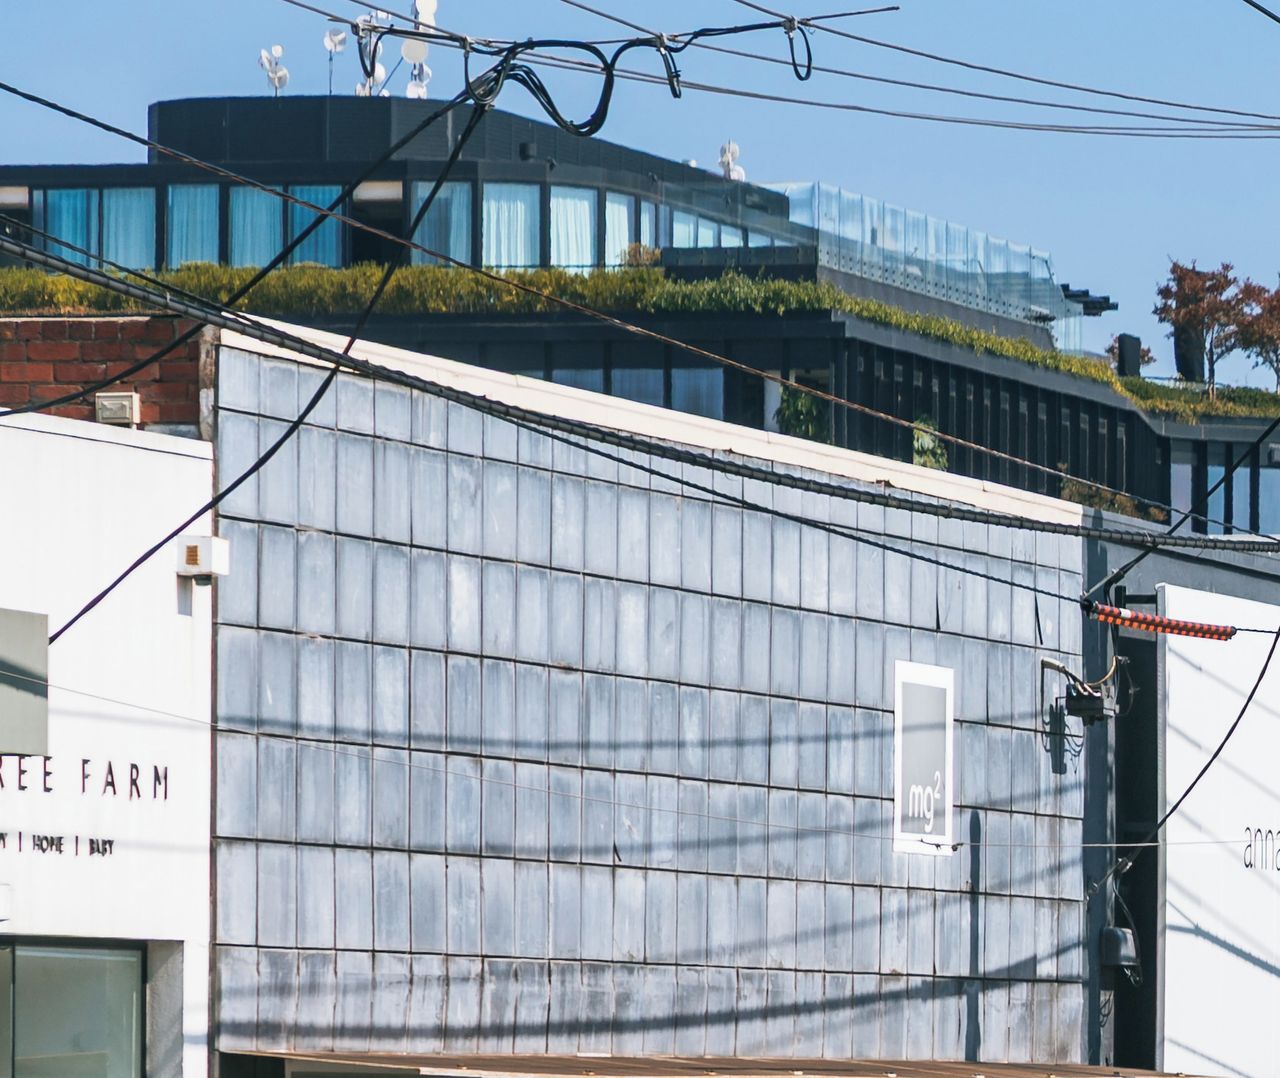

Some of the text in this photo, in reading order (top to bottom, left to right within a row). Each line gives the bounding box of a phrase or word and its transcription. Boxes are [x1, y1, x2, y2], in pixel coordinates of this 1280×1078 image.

[82, 759, 168, 800] FARM
[32, 834, 64, 854] HOME
[89, 838, 115, 857] BABY
